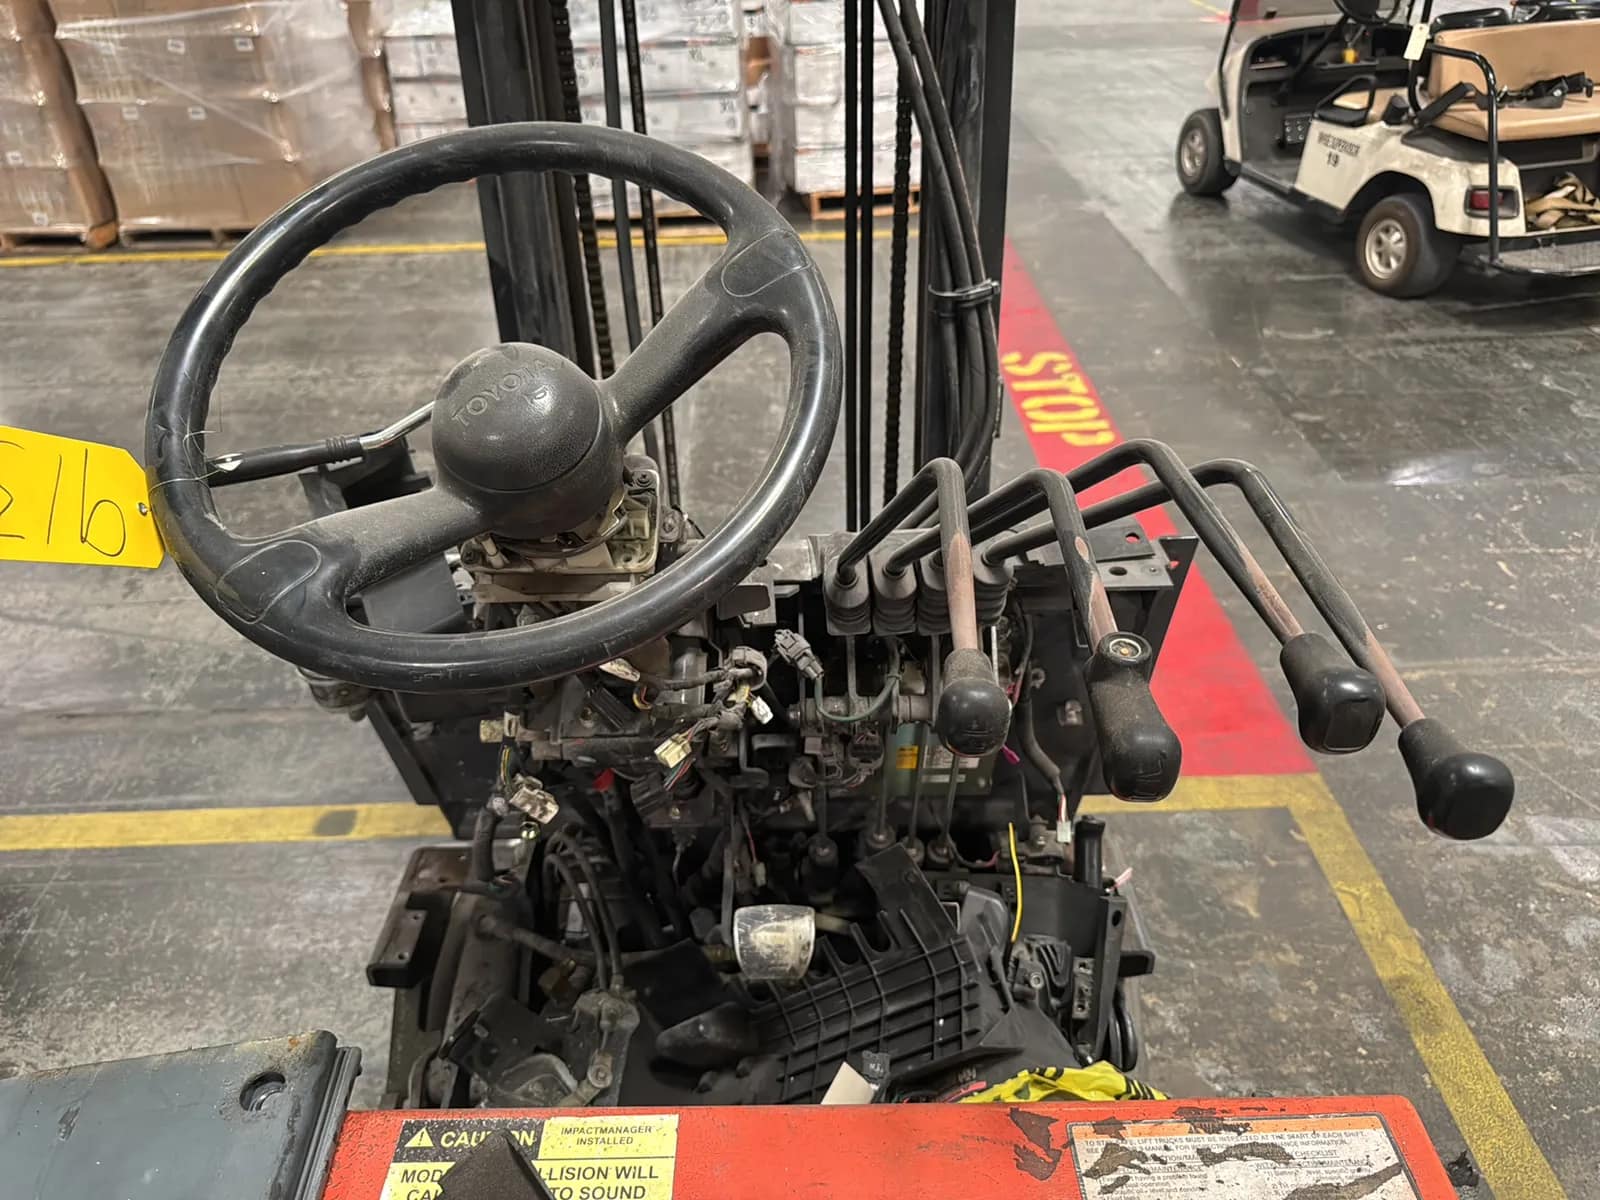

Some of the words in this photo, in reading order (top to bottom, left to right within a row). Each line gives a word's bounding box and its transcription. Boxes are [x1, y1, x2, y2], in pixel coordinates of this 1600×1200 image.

[1327, 151, 1340, 168] 19
[1001, 352, 1115, 446] STOP
[561, 1126, 652, 1135] IMPACTMANAGER
[440, 1130, 535, 1148] CAUN
[576, 1136, 634, 1146] INSTALLED
[1155, 1136, 1184, 1145] TRUCKS
[1294, 1149, 1338, 1157] CHECKLIST
[538, 1166, 609, 1181] LLISION
[615, 1165, 659, 1179] WILL
[579, 1186, 646, 1200] SOUND
